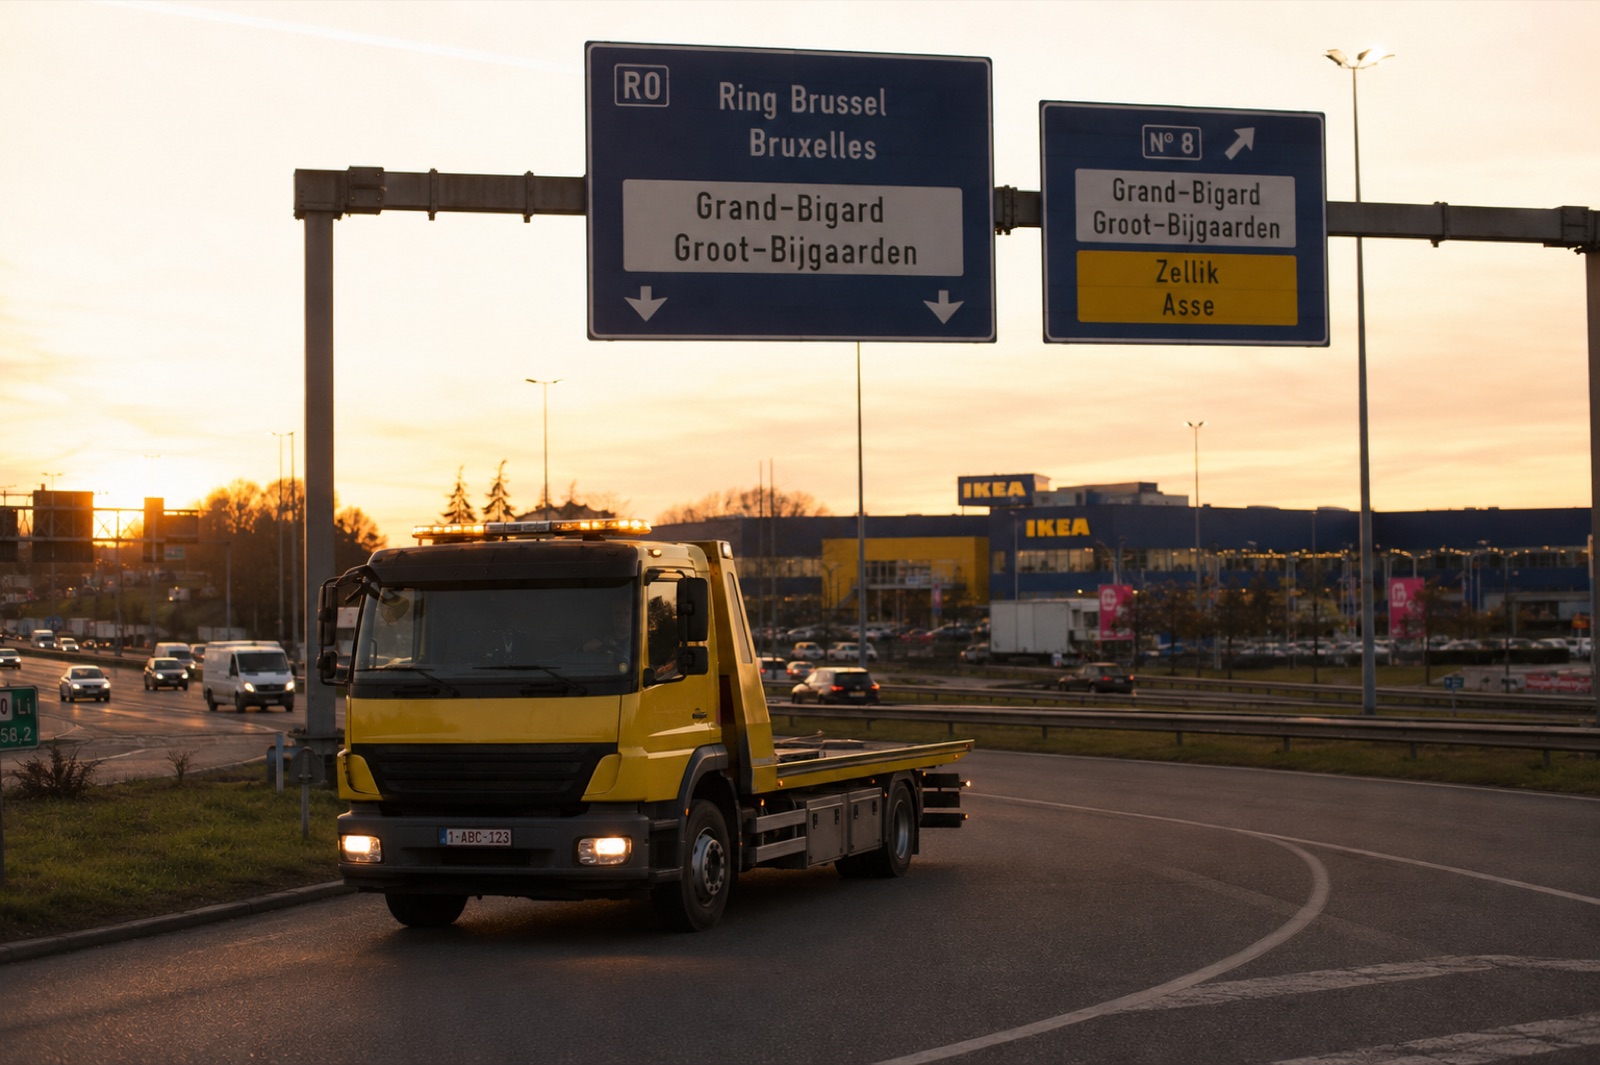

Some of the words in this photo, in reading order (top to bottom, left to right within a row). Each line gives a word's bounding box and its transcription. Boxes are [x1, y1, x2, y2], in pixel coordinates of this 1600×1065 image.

[718, 81, 777, 120] Ring
[791, 84, 887, 117] Brussel
[749, 128, 877, 160] Bruxelles
[1181, 132, 1194, 154] 8
[1112, 177, 1261, 211] Grand-Bigard
[696, 191, 884, 229] Grand-Bigard
[1093, 210, 1280, 243] Groot-Bijgaarden
[674, 233, 918, 272] Groot-Bijgaarden
[1155, 259, 1219, 285] Zellik
[1162, 292, 1215, 317] Asse
[963, 481, 1027, 498] IKEA
[1026, 517, 1091, 537] IKEA
[448, 831, 509, 844] 1-ABC-123
